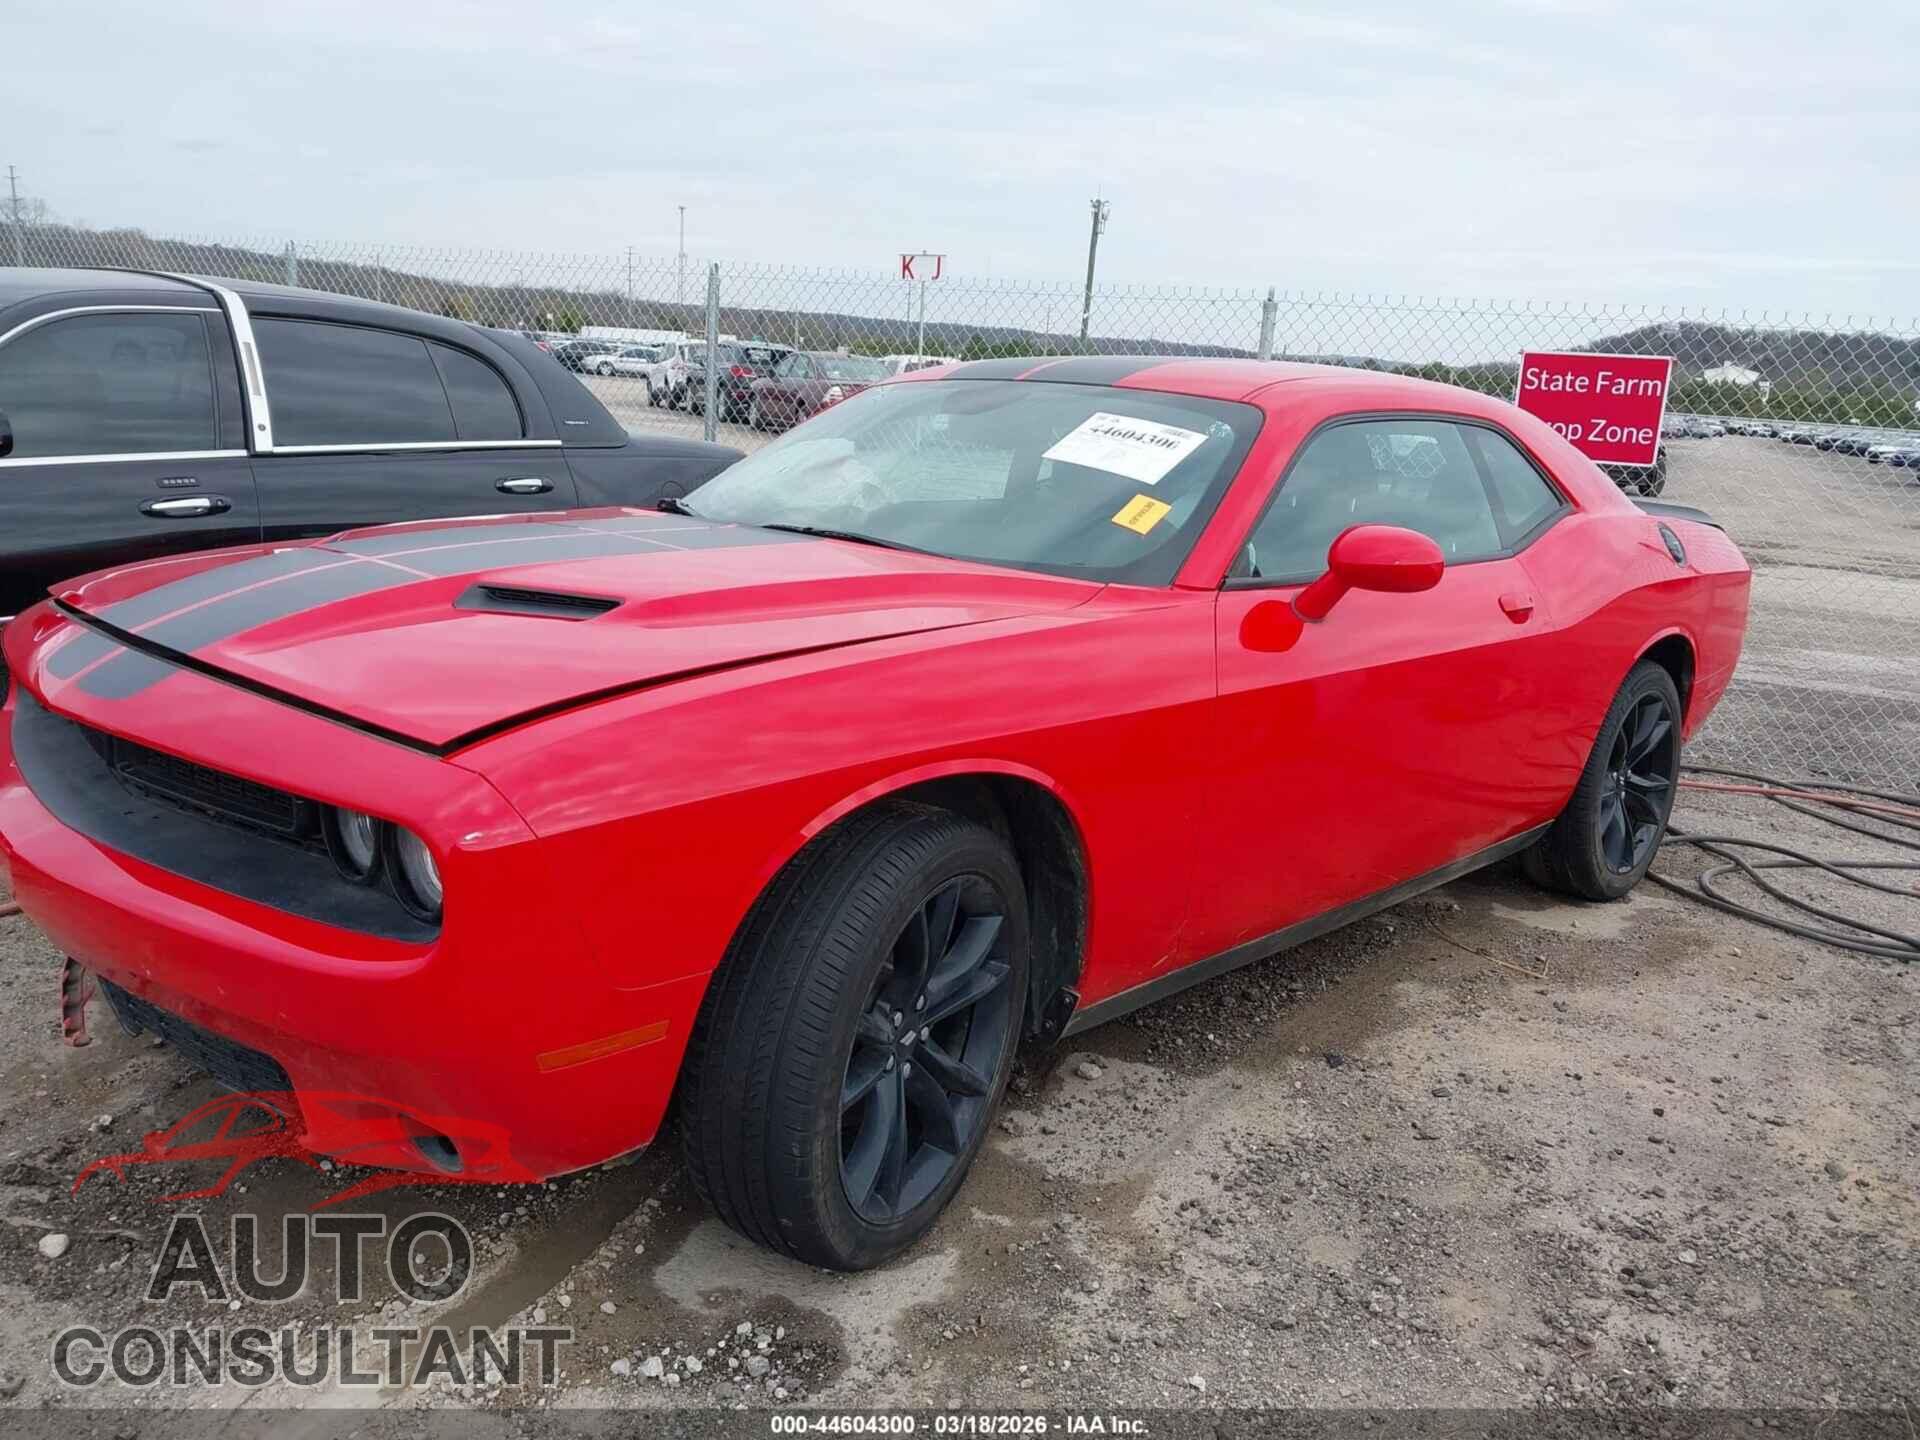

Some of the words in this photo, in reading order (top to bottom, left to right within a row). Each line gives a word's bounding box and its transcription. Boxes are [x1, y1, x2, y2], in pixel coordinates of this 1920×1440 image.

[902, 255, 914, 280] K
[931, 255, 941, 280] J
[1524, 367, 1590, 393] State
[1596, 371, 1662, 397] Farm
[1546, 421, 1583, 441] op
[1588, 419, 1654, 445] Zone
